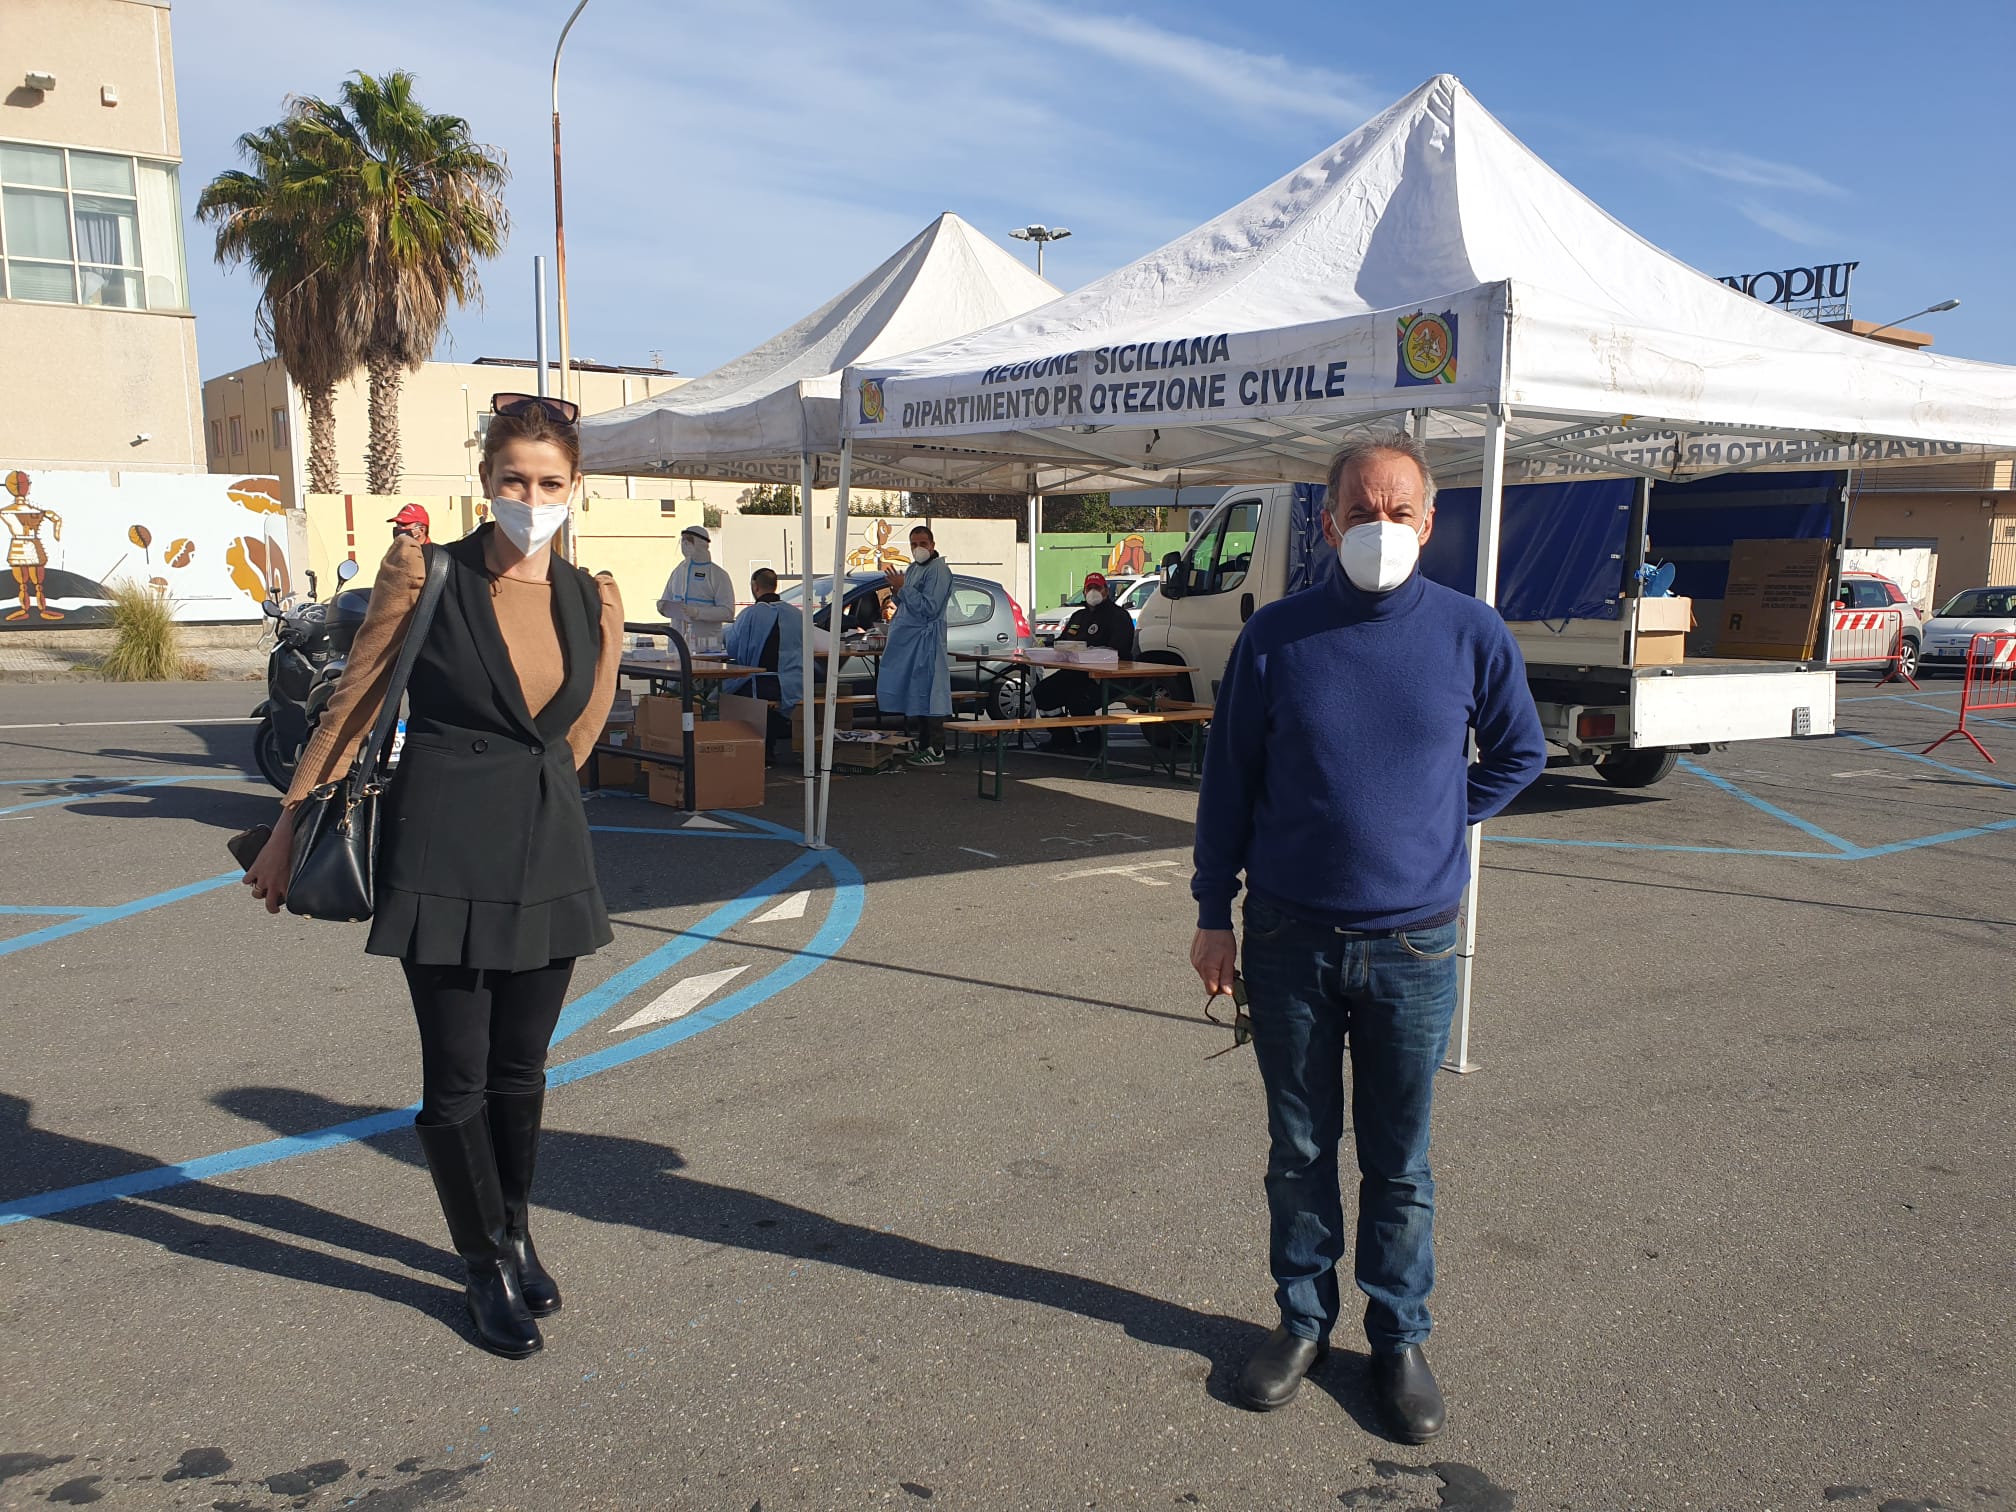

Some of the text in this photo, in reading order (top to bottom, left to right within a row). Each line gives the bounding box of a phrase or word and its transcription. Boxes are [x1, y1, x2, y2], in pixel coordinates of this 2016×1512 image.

[981, 333, 1230, 385] REGIONE SICILIANA
[1238, 361, 1348, 405] CIVILE
[1729, 613, 1743, 631] R
